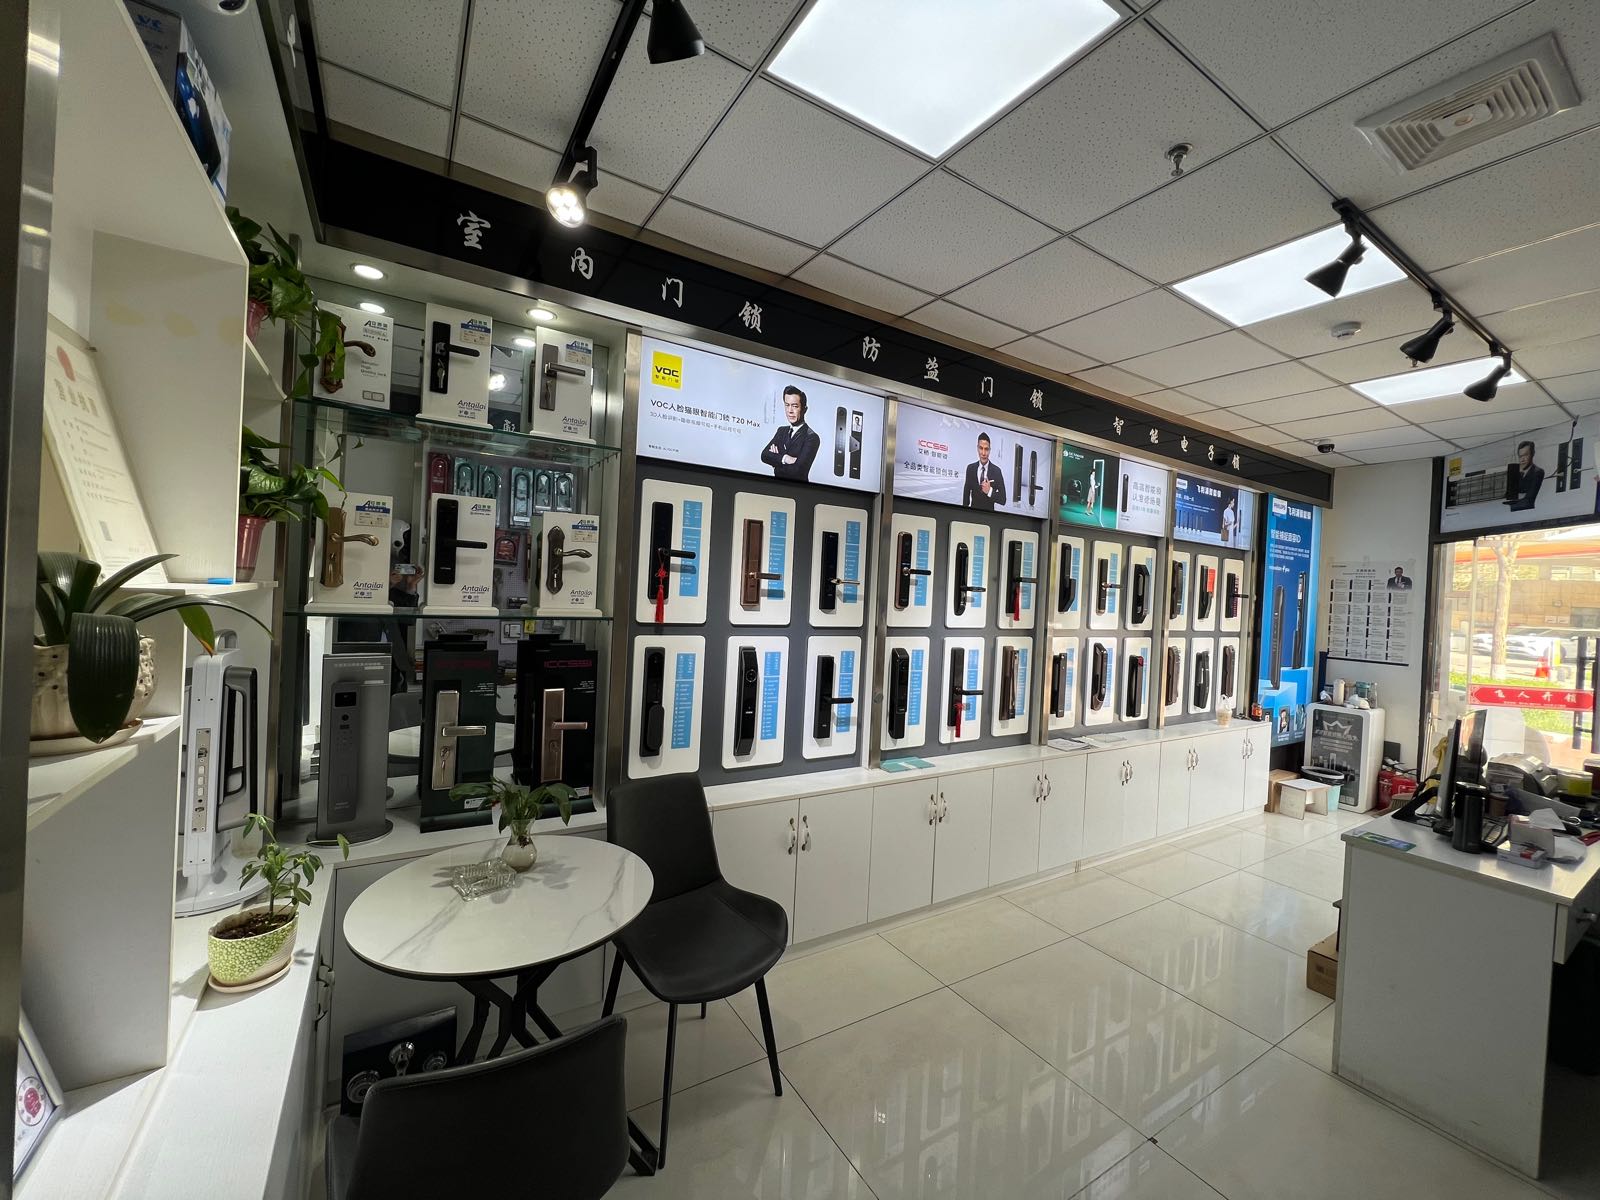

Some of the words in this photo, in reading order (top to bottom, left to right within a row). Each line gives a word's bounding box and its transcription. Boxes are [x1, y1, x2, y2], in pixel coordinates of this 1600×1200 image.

[457, 210, 763, 335] 室内门锁
[655, 366, 680, 378] VOC
[862, 335, 1044, 411] 防盗门锁
[457, 399, 487, 411] Antailai
[731, 415, 745, 425] T20
[746, 419, 760, 428] Max
[1112, 415, 1241, 471] 智能电子锁
[353, 581, 384, 590] Antailai
[461, 585, 490, 593] Antailai
